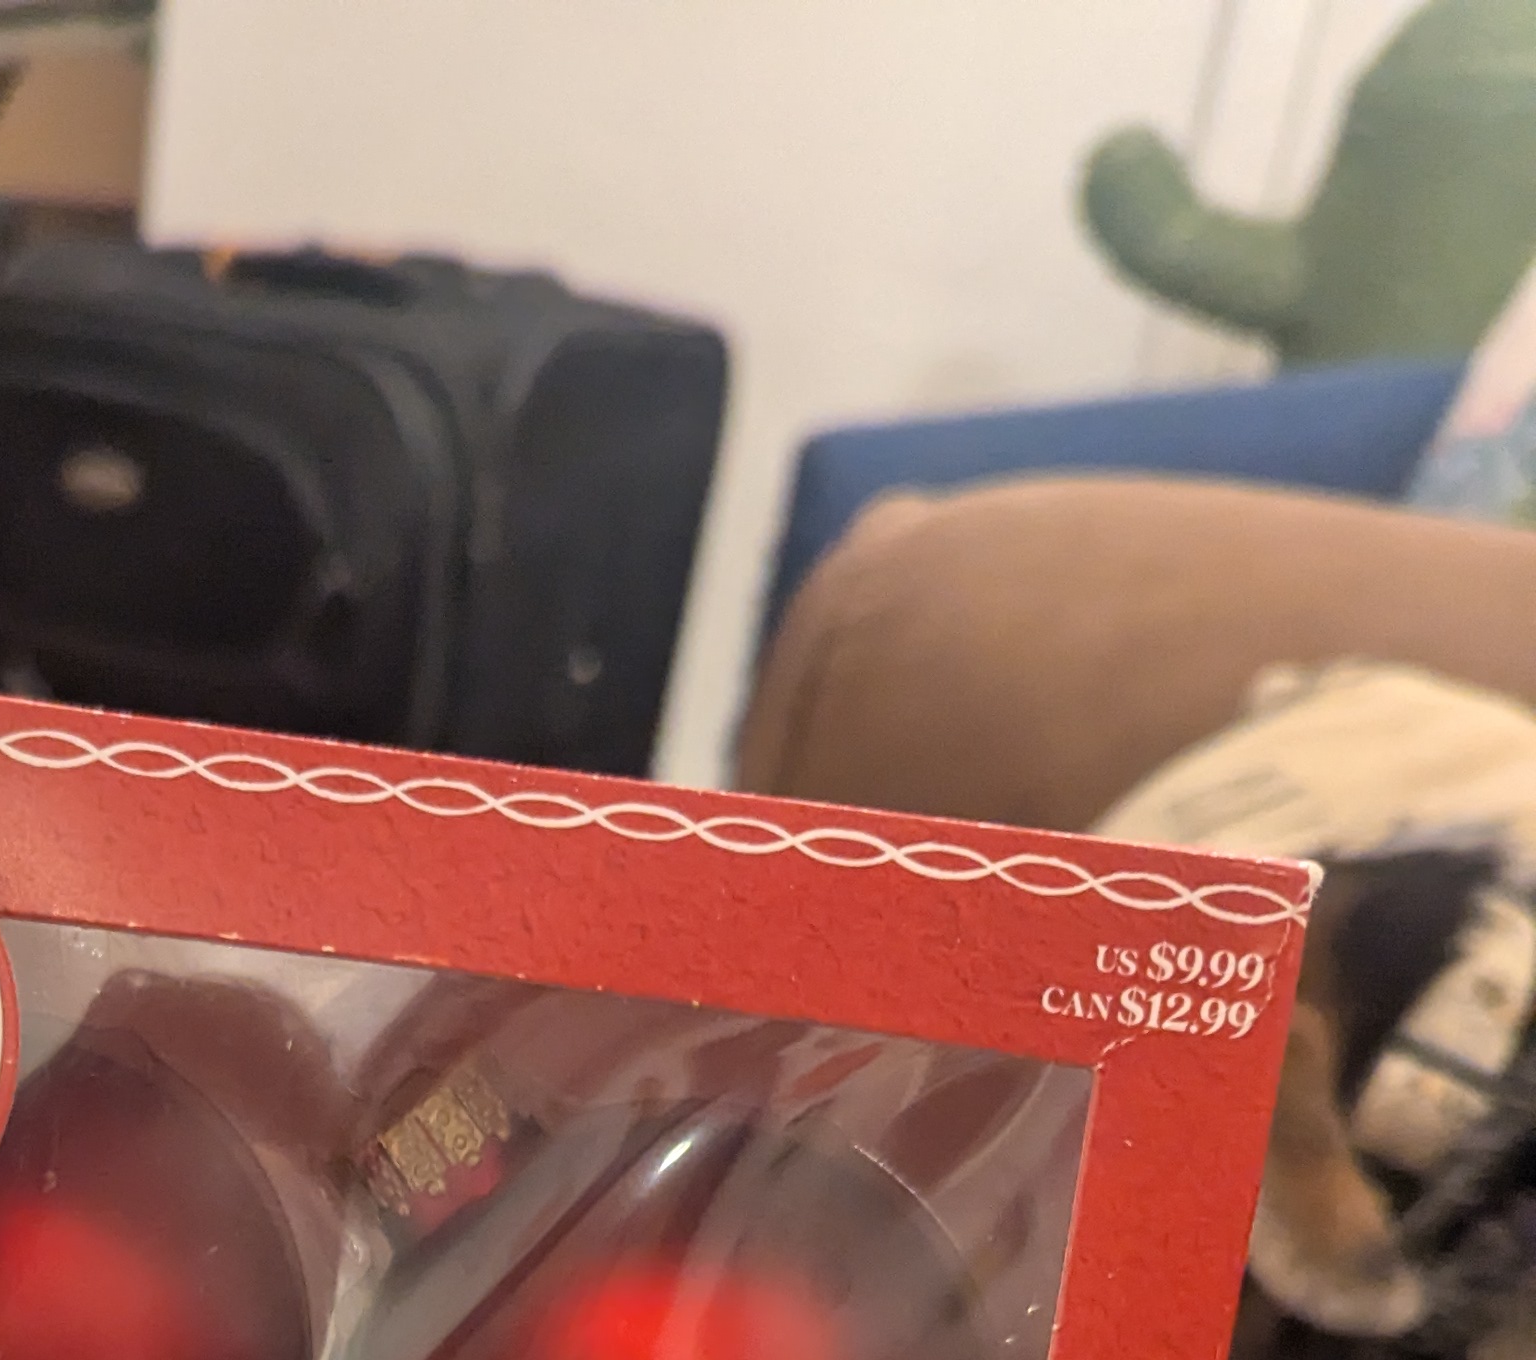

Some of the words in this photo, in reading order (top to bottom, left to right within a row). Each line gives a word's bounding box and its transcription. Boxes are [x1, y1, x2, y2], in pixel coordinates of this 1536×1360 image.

[1095, 943, 1139, 977] US
[1146, 940, 1265, 993] $9.99
[1041, 986, 1113, 1021] CAN
[1117, 985, 1257, 1040] $12.99
